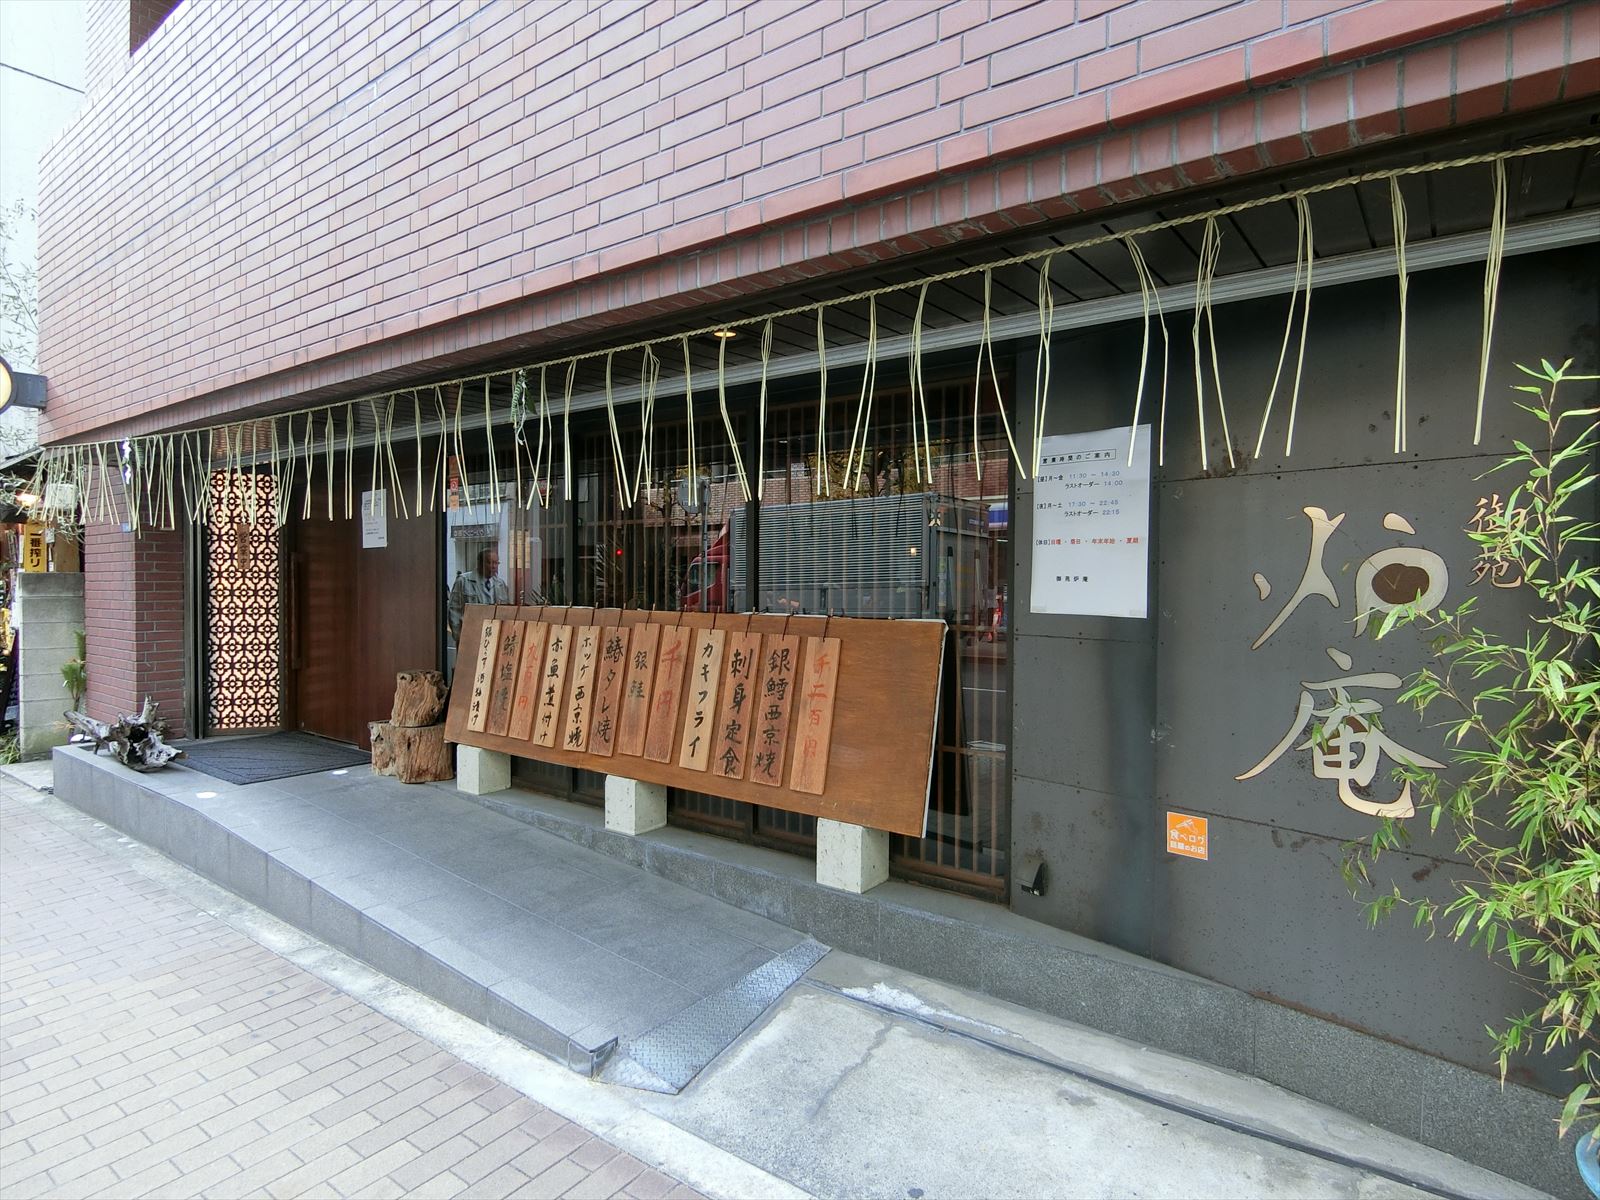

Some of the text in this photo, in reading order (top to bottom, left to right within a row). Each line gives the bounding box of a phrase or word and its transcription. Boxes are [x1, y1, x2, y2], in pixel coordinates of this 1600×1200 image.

[1042, 452, 1111, 464] 営業時間のご案内
[1065, 481, 1100, 489] ラストオーダー
[30, 533, 41, 567] 一番搾り
[1064, 509, 1099, 517] ラストオーダー
[539, 637, 563, 743] 赤魚煮付け
[567, 637, 592, 747] ホッケ西京焼
[656, 640, 682, 714] 千円
[688, 643, 713, 757] カキフライ
[719, 648, 753, 775] 刺身定食
[754, 648, 790, 778] 銀鱈西京焼
[803, 655, 831, 758] 千二百円
[1170, 829, 1205, 845] 食べログ
